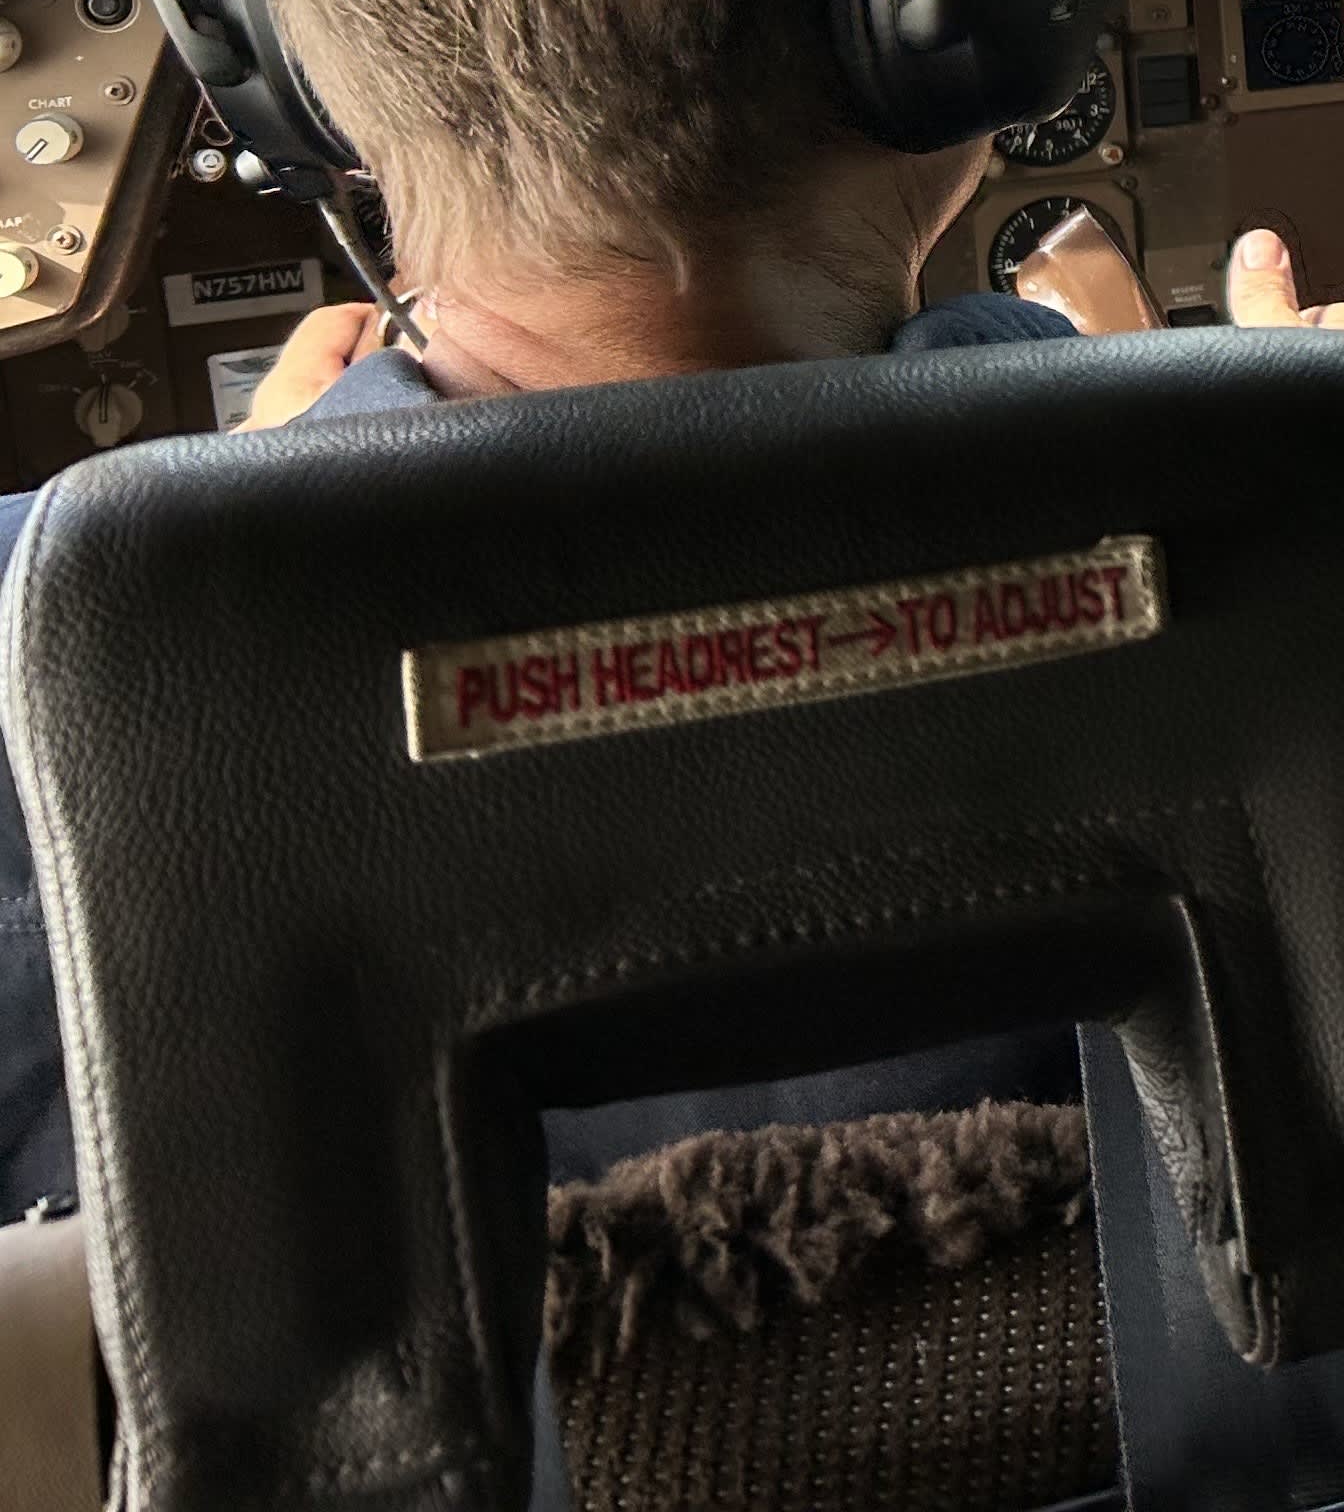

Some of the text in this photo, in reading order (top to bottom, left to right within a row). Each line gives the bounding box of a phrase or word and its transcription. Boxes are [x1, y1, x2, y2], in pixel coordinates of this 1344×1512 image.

[28, 96, 73, 110] CHART
[1090, 104, 1099, 116] 3
[194, 270, 303, 298] N757HW
[455, 564, 1129, 728] PUSH HEADREST TO ADJUST
